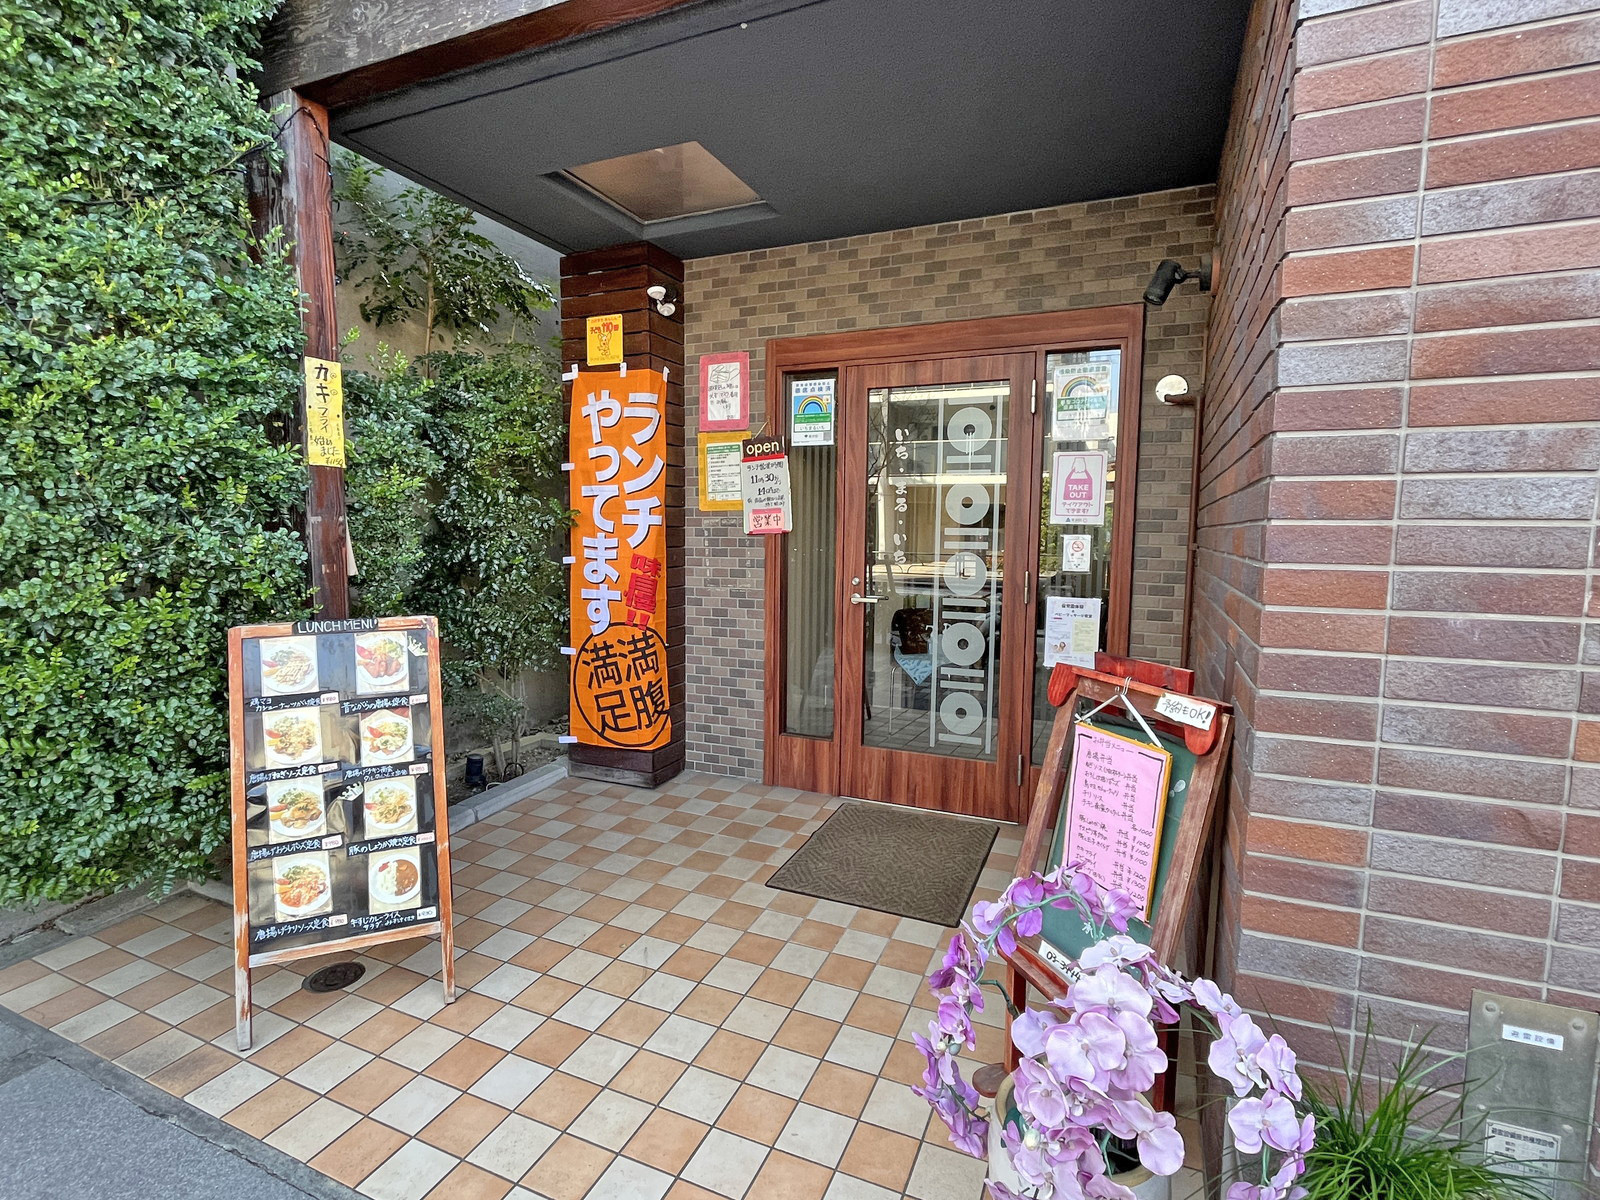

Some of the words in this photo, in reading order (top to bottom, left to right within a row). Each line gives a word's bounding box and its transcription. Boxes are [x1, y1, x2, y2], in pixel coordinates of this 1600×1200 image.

[621, 392, 665, 549] ランチ
[746, 441, 779, 457] open
[581, 389, 623, 636] やってます
[297, 620, 341, 634] LUNCH
